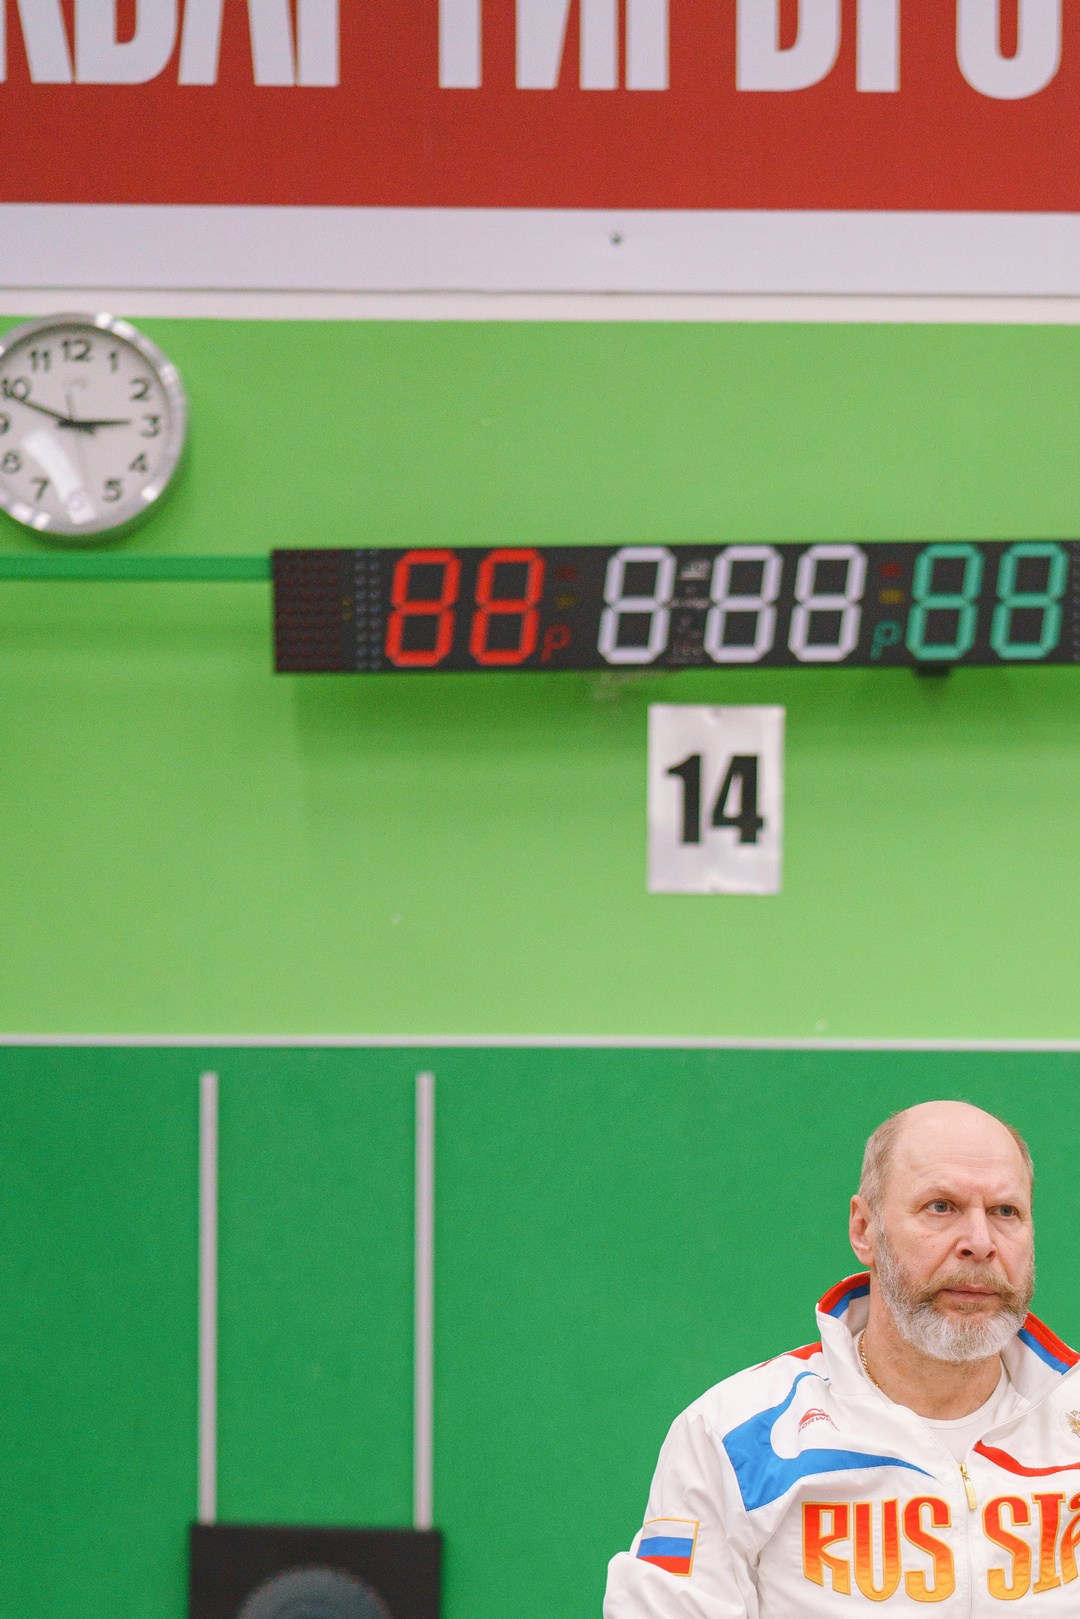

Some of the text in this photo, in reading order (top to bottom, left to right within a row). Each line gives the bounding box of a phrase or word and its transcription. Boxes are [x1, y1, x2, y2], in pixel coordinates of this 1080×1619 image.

[30, 350, 50, 373] 11
[62, 338, 92, 362] 12
[108, 351, 119, 373] 1
[130, 378, 151, 401] 2
[142, 415, 160, 438] 3
[2, 451, 22, 473] 8
[130, 453, 148, 474] 4
[32, 477, 50, 500] 7
[103, 479, 122, 502] 5
[385, 548, 546, 667] 88
[905, 542, 1069, 661] 88
[665, 752, 764, 846] 14
